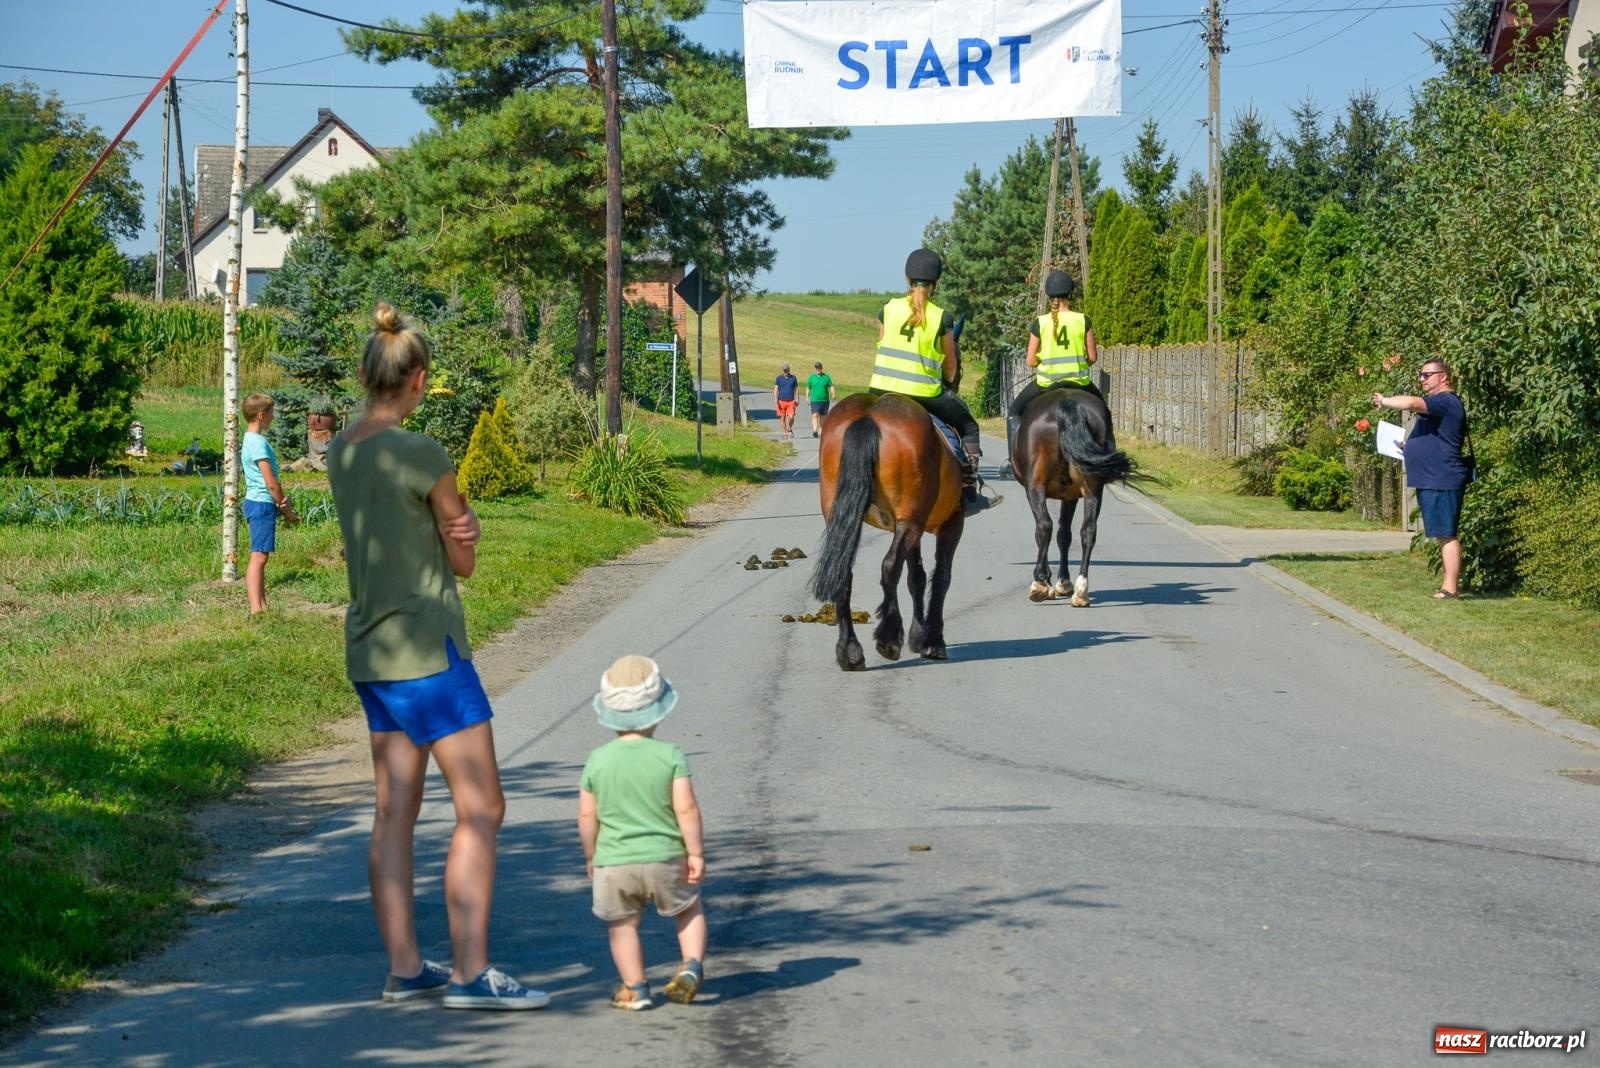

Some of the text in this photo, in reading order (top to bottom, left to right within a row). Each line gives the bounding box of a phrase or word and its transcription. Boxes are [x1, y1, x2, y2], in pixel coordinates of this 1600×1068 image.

[774, 66, 804, 74] RUDNIK
[837, 34, 1032, 90] START
[899, 319, 915, 343] 4
[1056, 325, 1070, 350] 4
